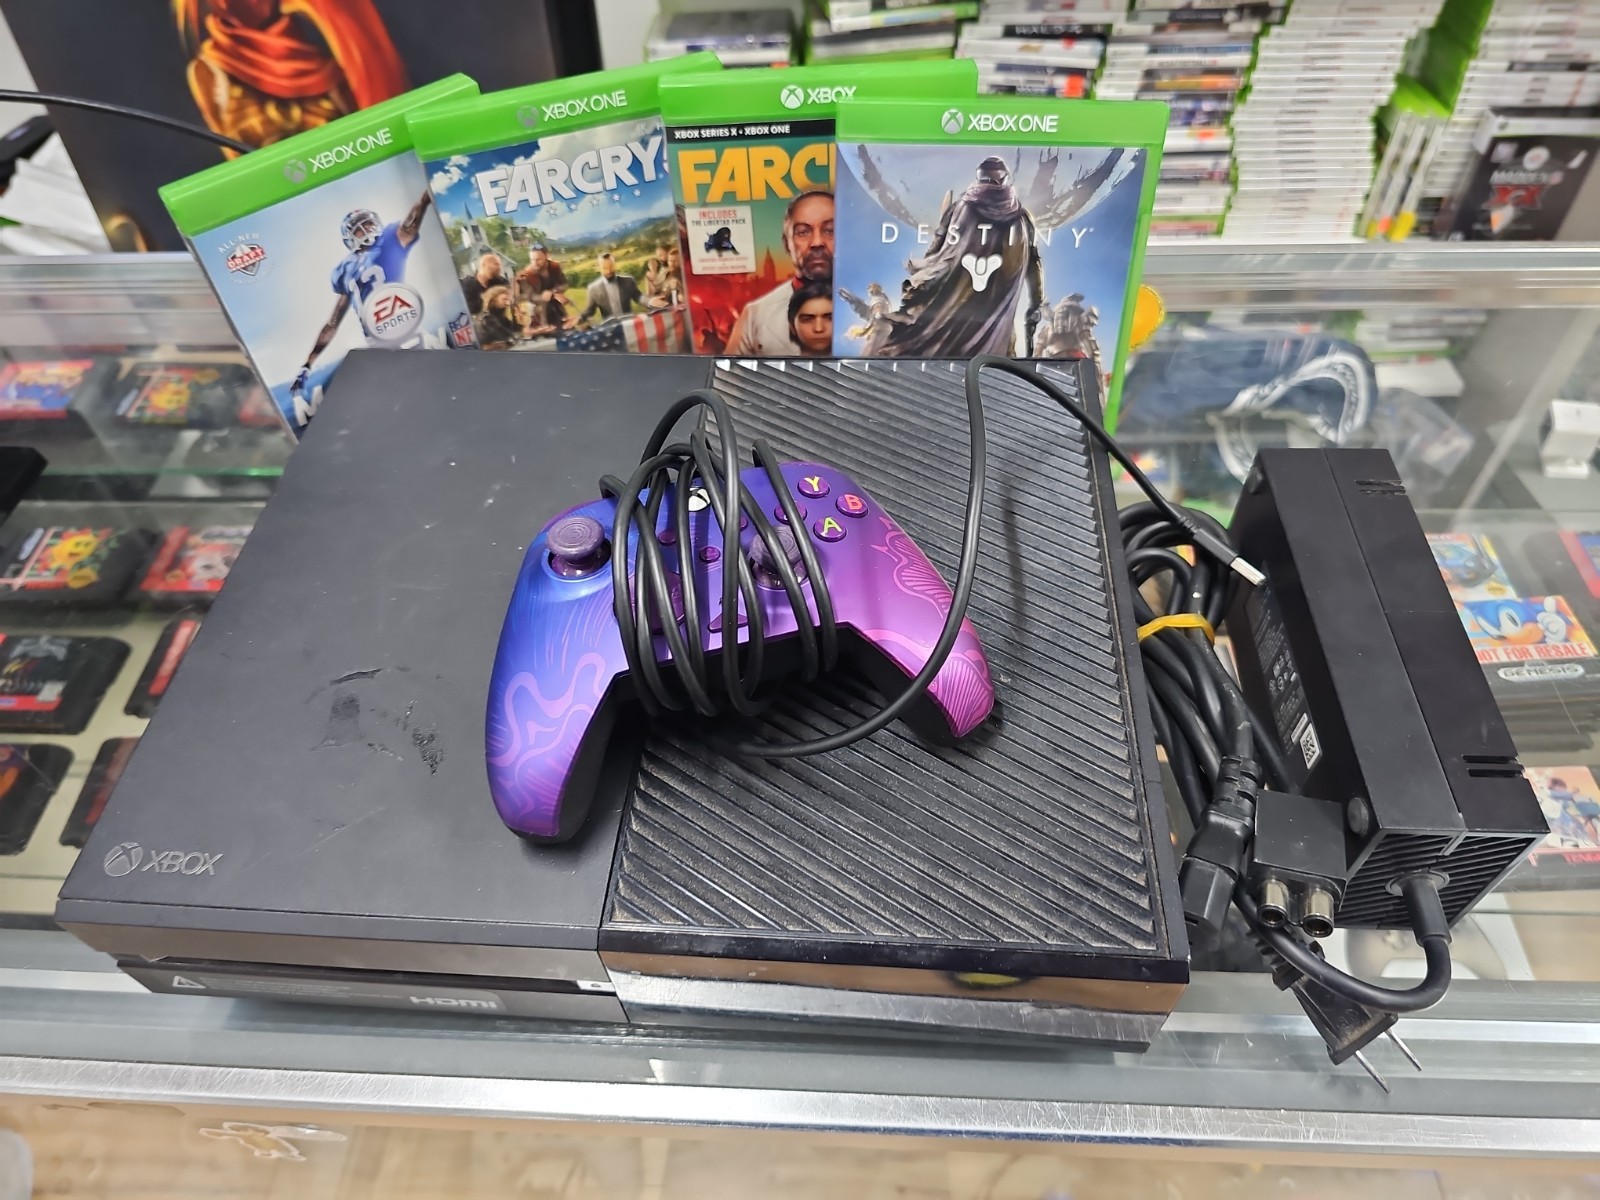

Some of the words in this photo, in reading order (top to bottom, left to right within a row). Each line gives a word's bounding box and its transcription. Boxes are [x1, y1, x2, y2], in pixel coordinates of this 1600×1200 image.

[807, 86, 857, 105] XBOX
[541, 98, 591, 122] XBOX
[591, 90, 628, 112] ONE
[674, 130, 700, 139] XBOX
[700, 128, 729, 138] SERIES
[730, 128, 738, 136] X
[744, 126, 769, 135] XBOX
[770, 125, 791, 134] ONE
[968, 114, 1018, 132] XBOX
[1018, 115, 1059, 133] ONE
[308, 142, 358, 173] XBOX
[356, 127, 394, 153] ONE
[677, 143, 836, 203] FARC
[698, 209, 737, 219] INCLUDES
[881, 222, 1088, 249] DESTINY
[373, 294, 413, 325] EA
[375, 309, 418, 335] SPORTS
[803, 476, 820, 491] Y
[844, 494, 863, 510] B
[822, 517, 842, 534] A
[1503, 645, 1534, 660] FOR
[1534, 642, 1589, 659] RESALE
[1503, 665, 1579, 677] GENESIS
[141, 850, 224, 876] XBOX
[409, 996, 498, 1008] HDMI
